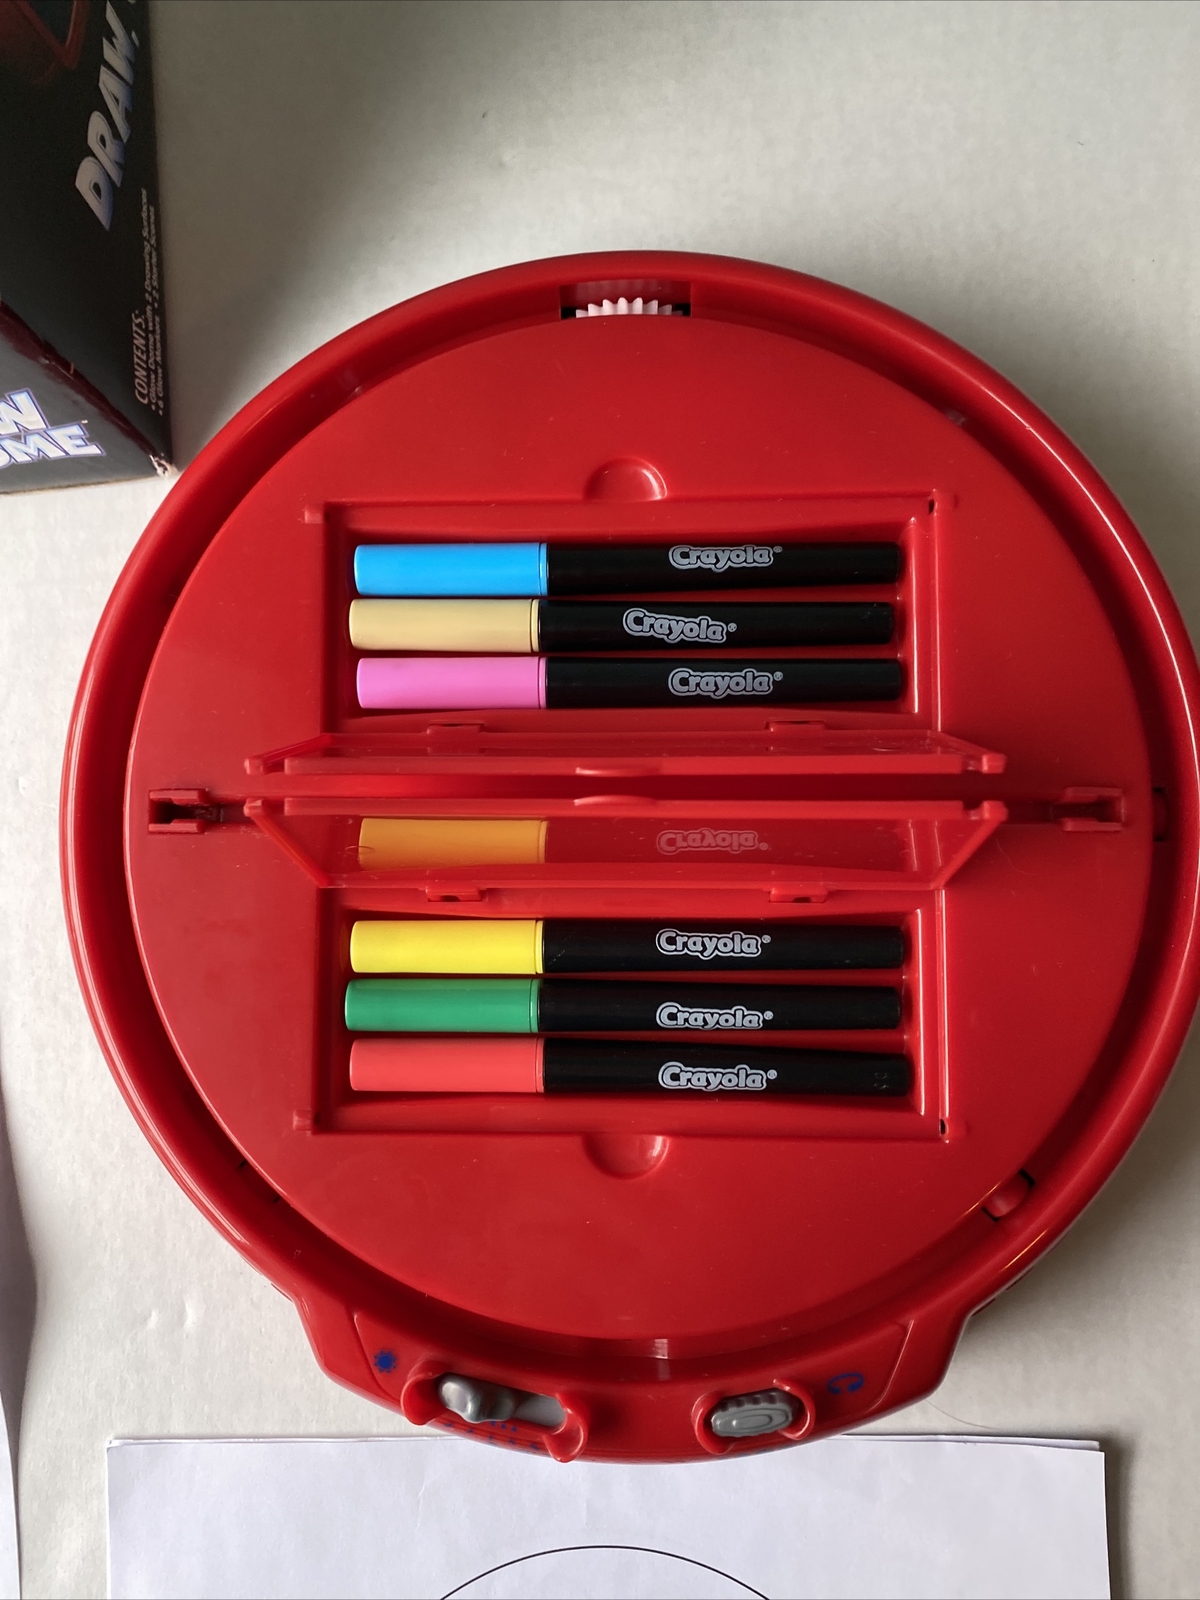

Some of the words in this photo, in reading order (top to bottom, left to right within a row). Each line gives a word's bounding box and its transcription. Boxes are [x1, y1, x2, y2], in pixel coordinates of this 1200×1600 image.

[141, 188, 149, 240] Surfaces
[143, 241, 151, 292] Drawing
[132, 310, 148, 404] CONTENTS:
[156, 365, 164, 397] Glow
[149, 371, 157, 403] Glow
[0, 421, 106, 469] ME
